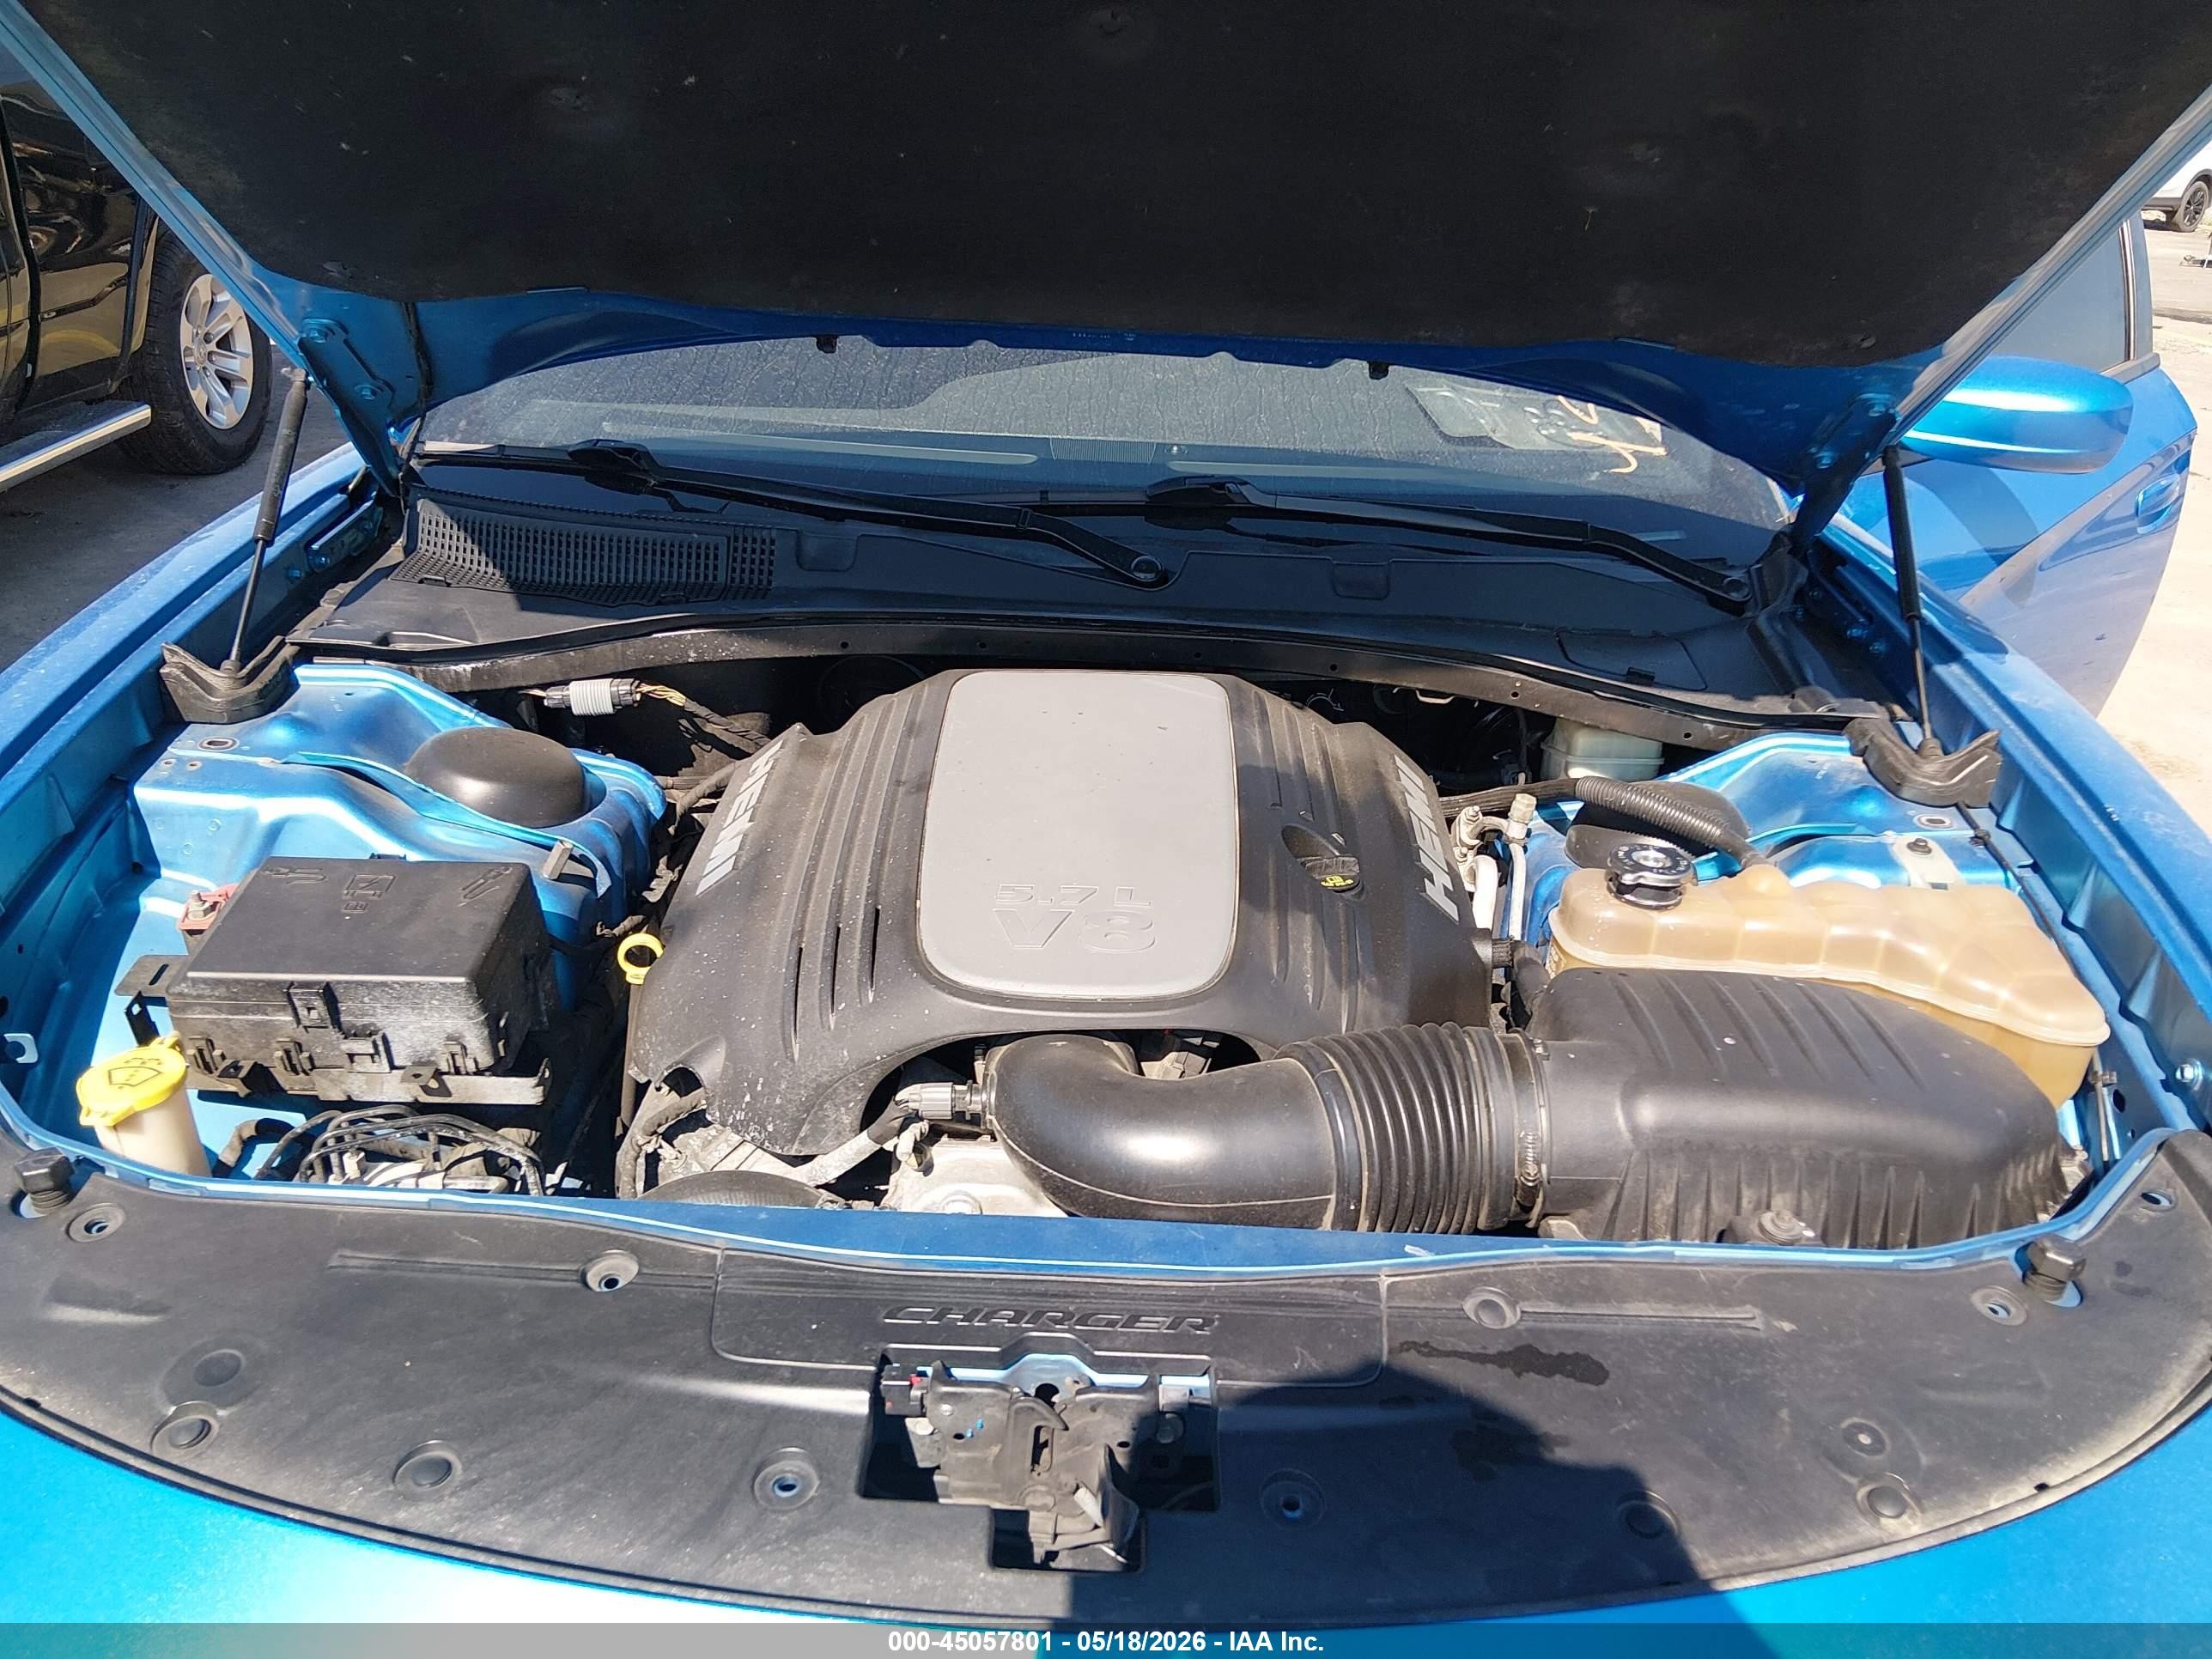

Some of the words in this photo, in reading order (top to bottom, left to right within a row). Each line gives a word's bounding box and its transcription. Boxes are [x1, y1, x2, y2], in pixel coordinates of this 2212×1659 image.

[695, 739, 783, 896] HEMI
[1394, 754, 1460, 922] HEMI
[992, 908, 1157, 953] V8
[883, 1305, 1217, 1334] CHARGER
